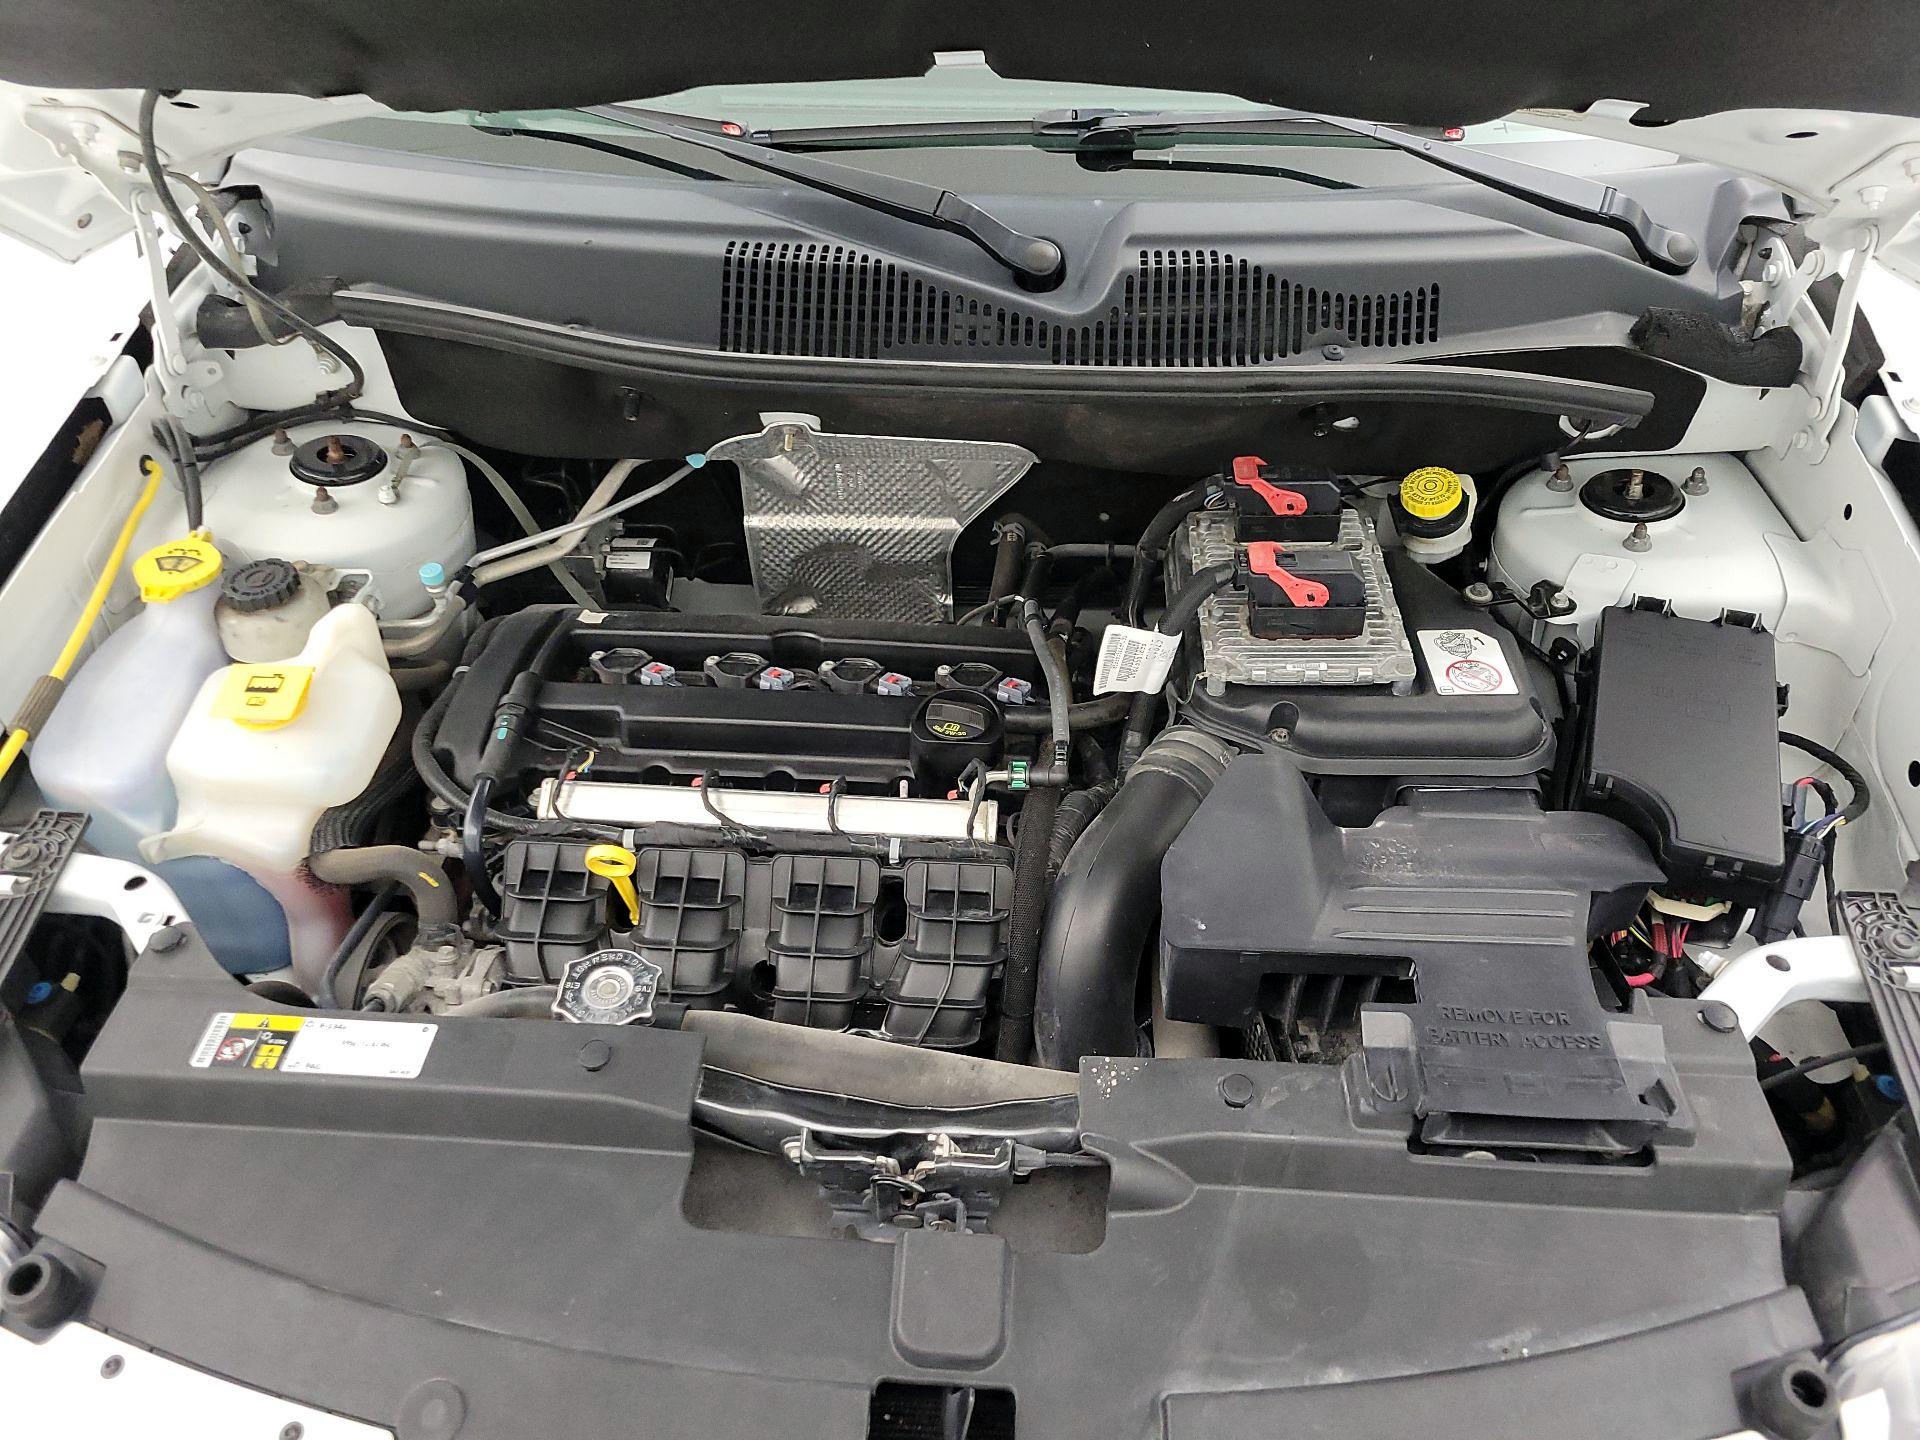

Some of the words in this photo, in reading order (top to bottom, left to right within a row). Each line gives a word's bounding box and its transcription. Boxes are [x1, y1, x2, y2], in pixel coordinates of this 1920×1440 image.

[1440, 1006, 1524, 1025] REMOVE
[1527, 1009, 1572, 1026] FOR
[1426, 1026, 1511, 1048] BATTERY
[1521, 1035, 1601, 1049] ACCESS
